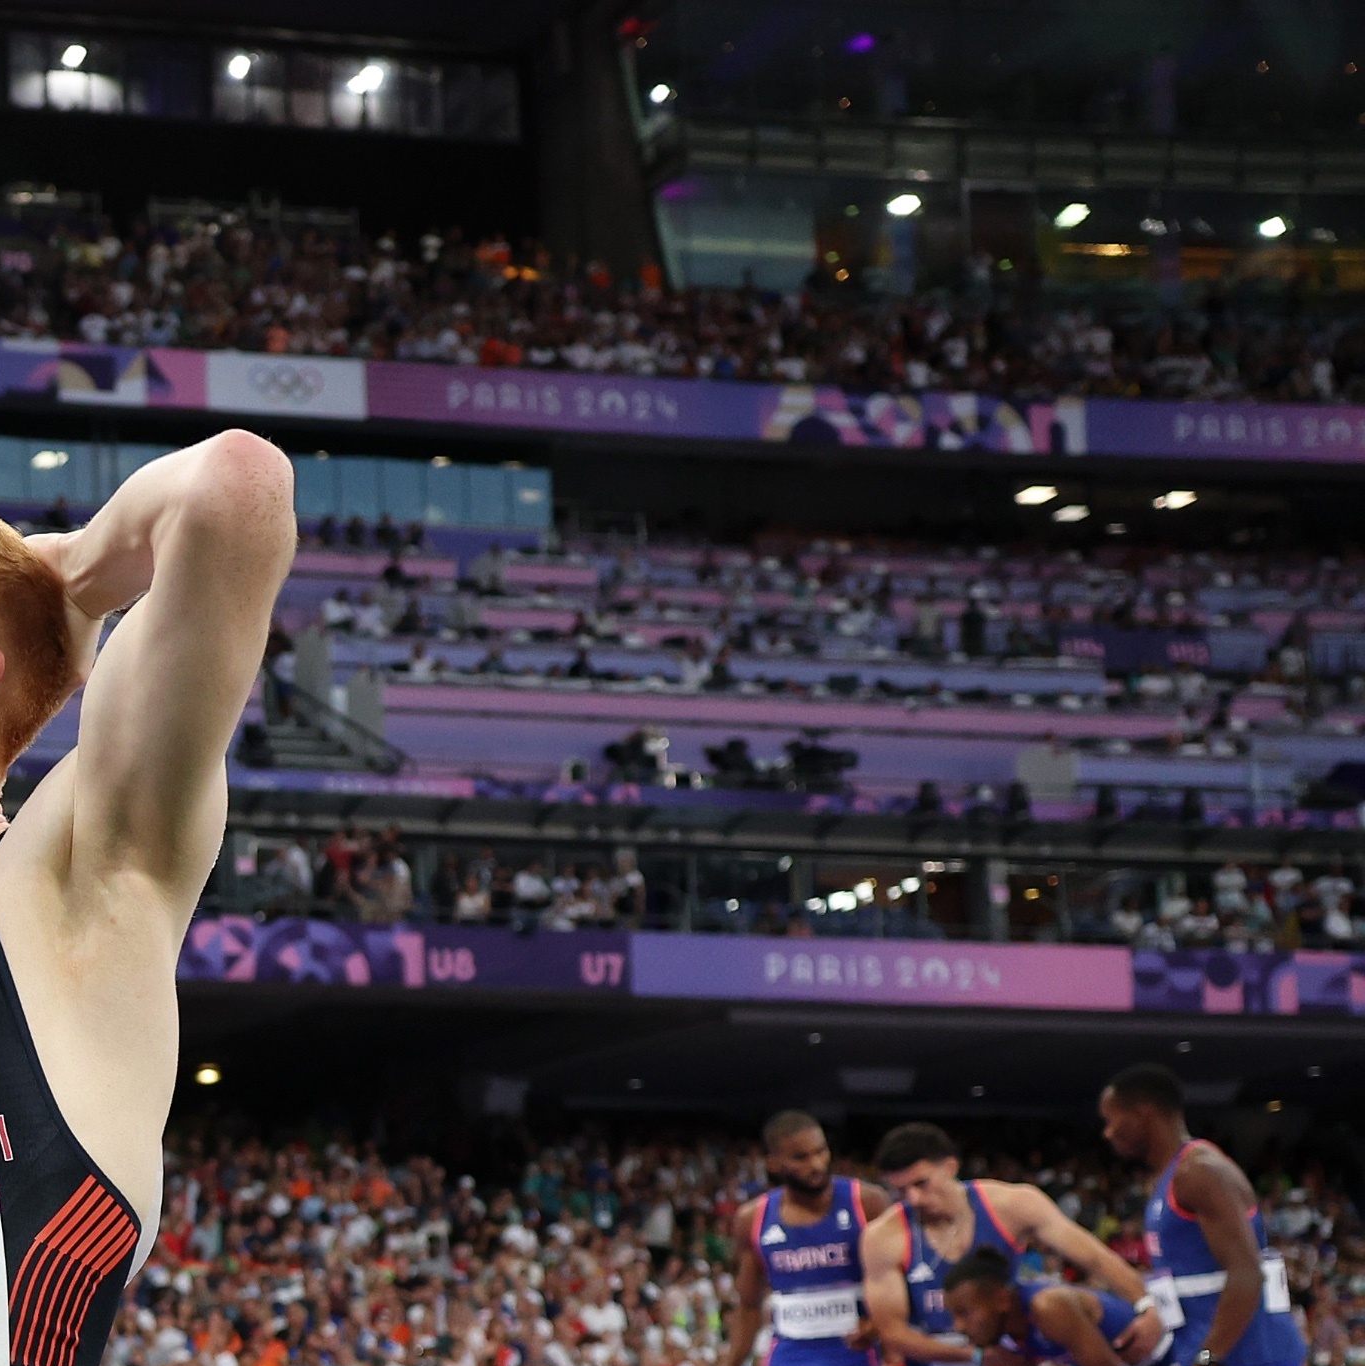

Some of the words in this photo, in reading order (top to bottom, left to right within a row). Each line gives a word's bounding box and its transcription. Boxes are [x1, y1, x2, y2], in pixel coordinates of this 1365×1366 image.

[581, 952, 625, 986] U7
[895, 955, 1001, 991] 2024
[771, 1242, 851, 1273] FRANCE
